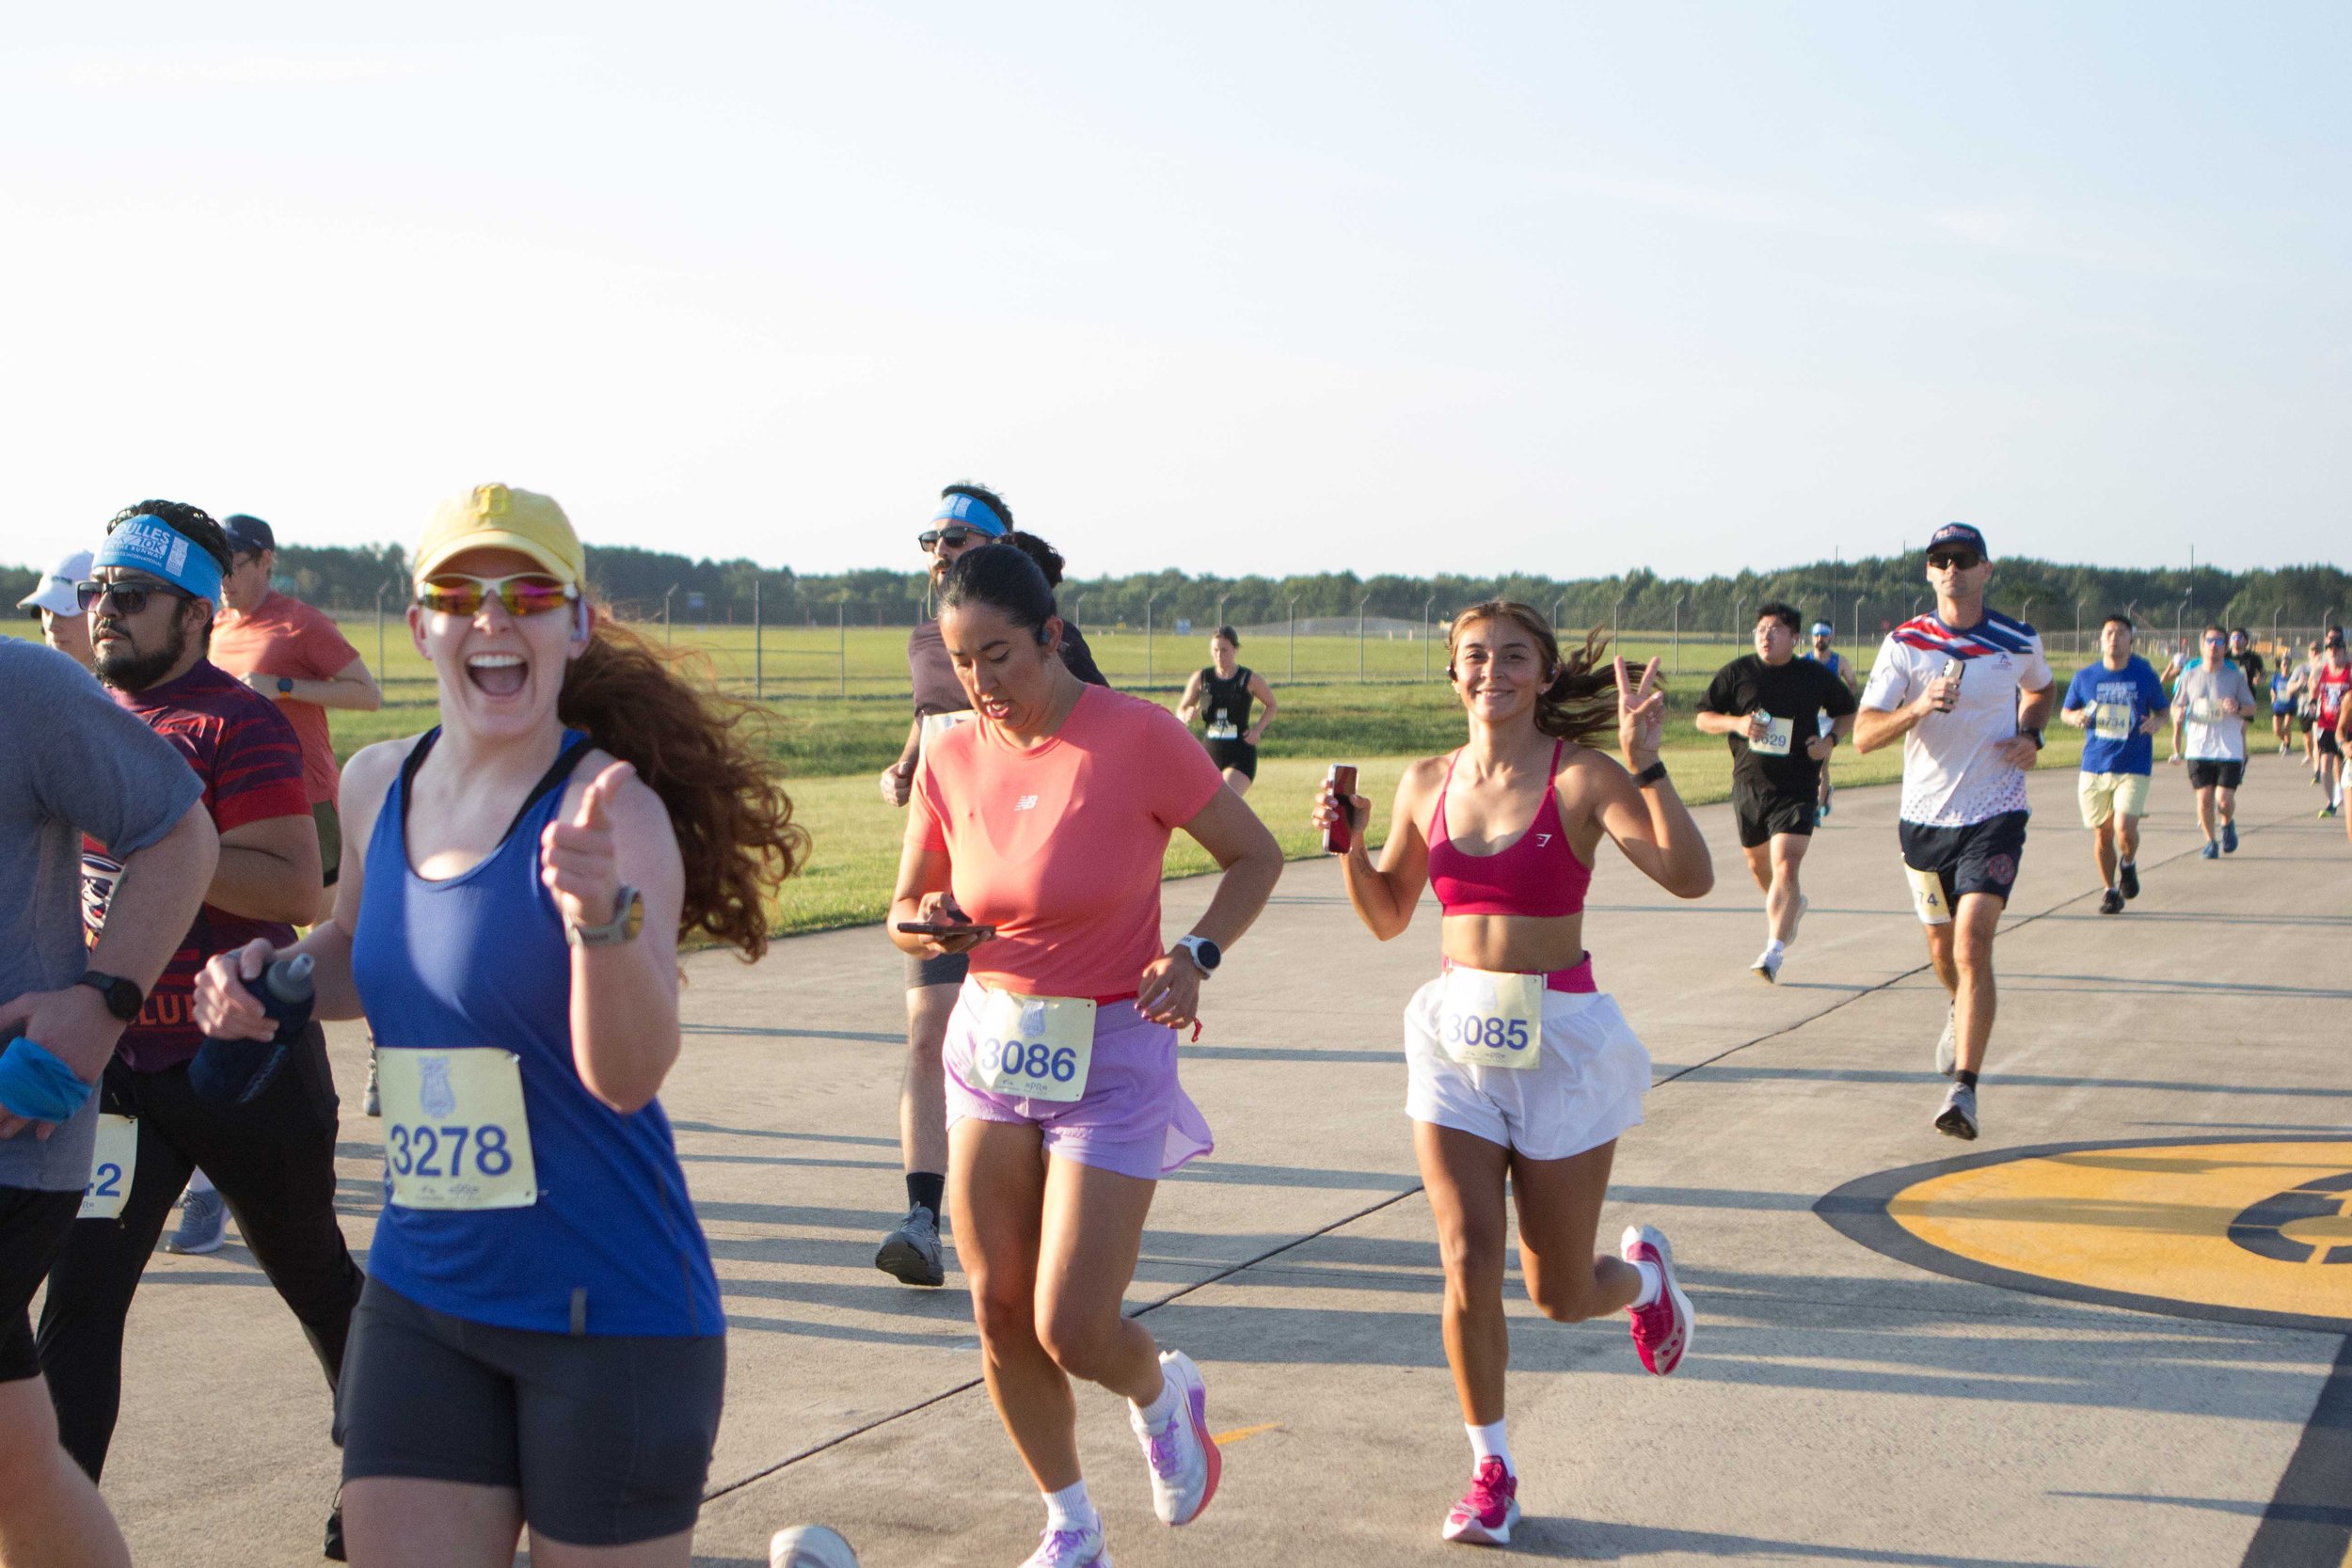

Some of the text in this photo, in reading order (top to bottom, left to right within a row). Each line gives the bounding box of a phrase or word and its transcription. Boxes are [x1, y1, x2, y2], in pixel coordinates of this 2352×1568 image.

[1446, 1013, 1529, 1051] 3085
[981, 1037, 1077, 1083] 3086
[390, 1123, 513, 1177] 3278
